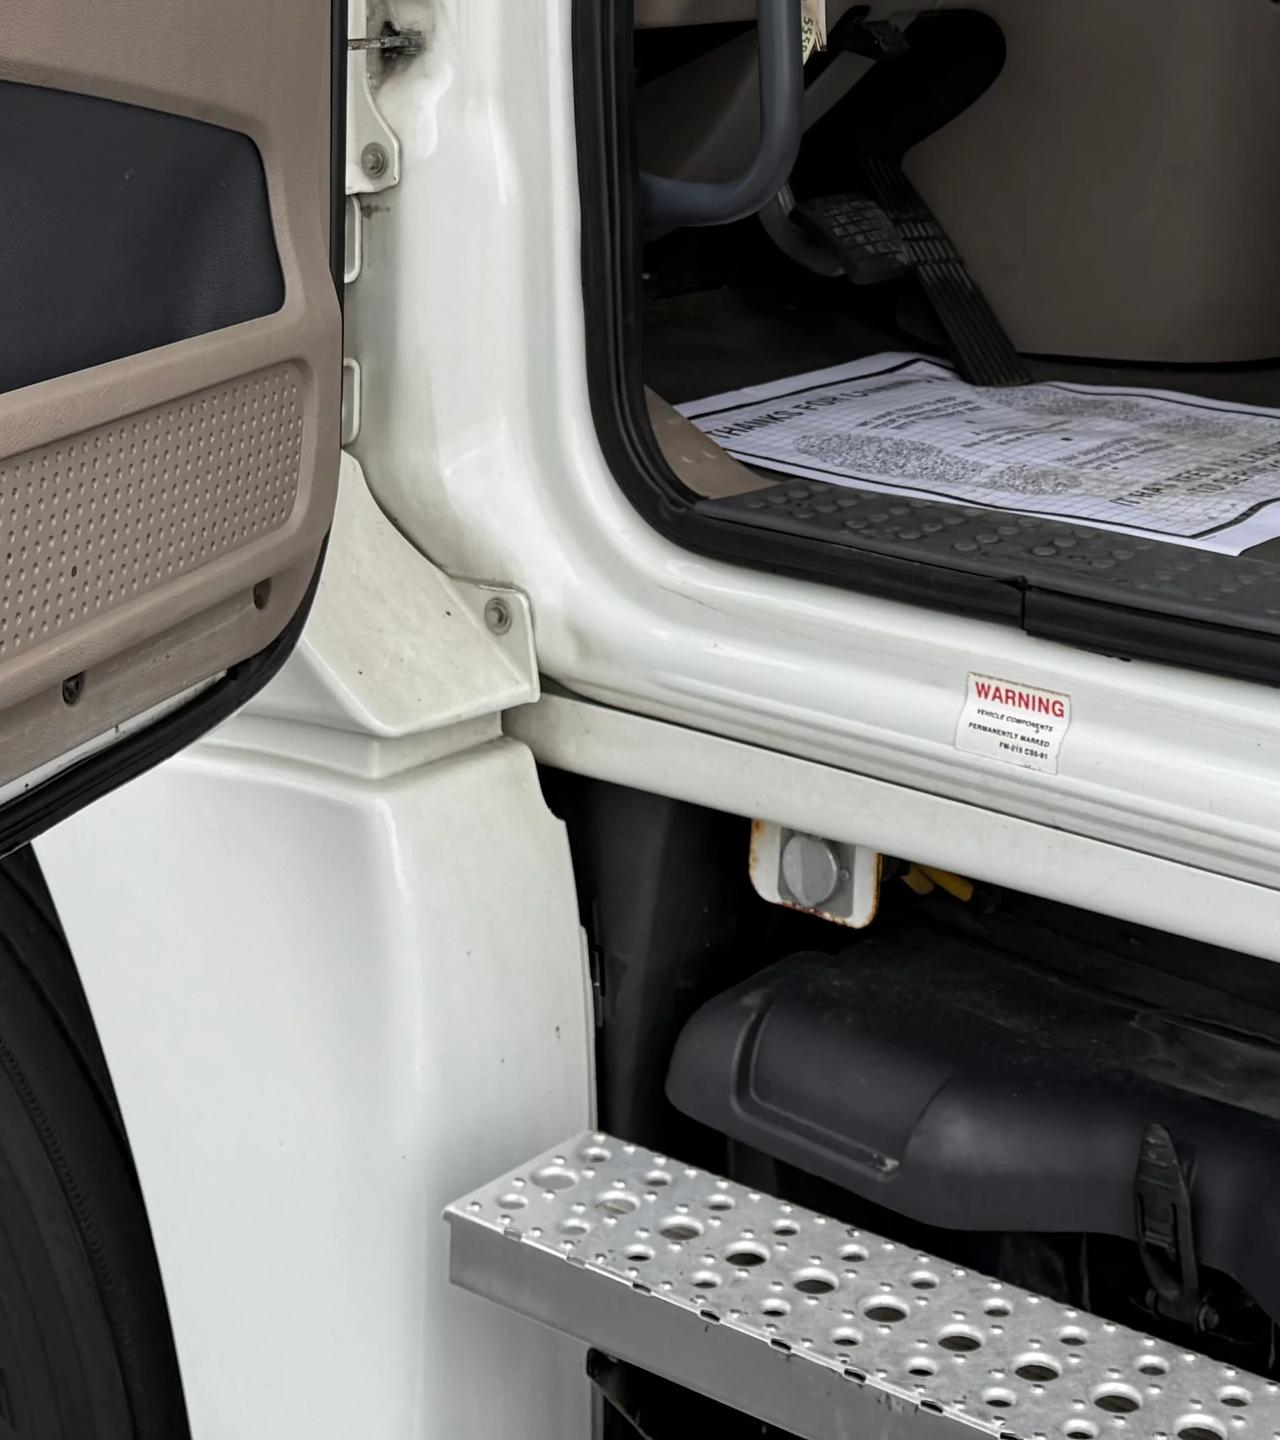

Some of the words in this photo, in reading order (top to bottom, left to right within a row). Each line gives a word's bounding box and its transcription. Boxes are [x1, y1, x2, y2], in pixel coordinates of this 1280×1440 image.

[704, 410, 803, 439] THANKS
[975, 681, 1065, 718] WARNING
[977, 709, 1005, 720] VEHICLE
[1006, 716, 1053, 732] COMPONENTS
[968, 722, 1018, 740] PERMANENTLY
[1020, 735, 1050, 748] MARKED
